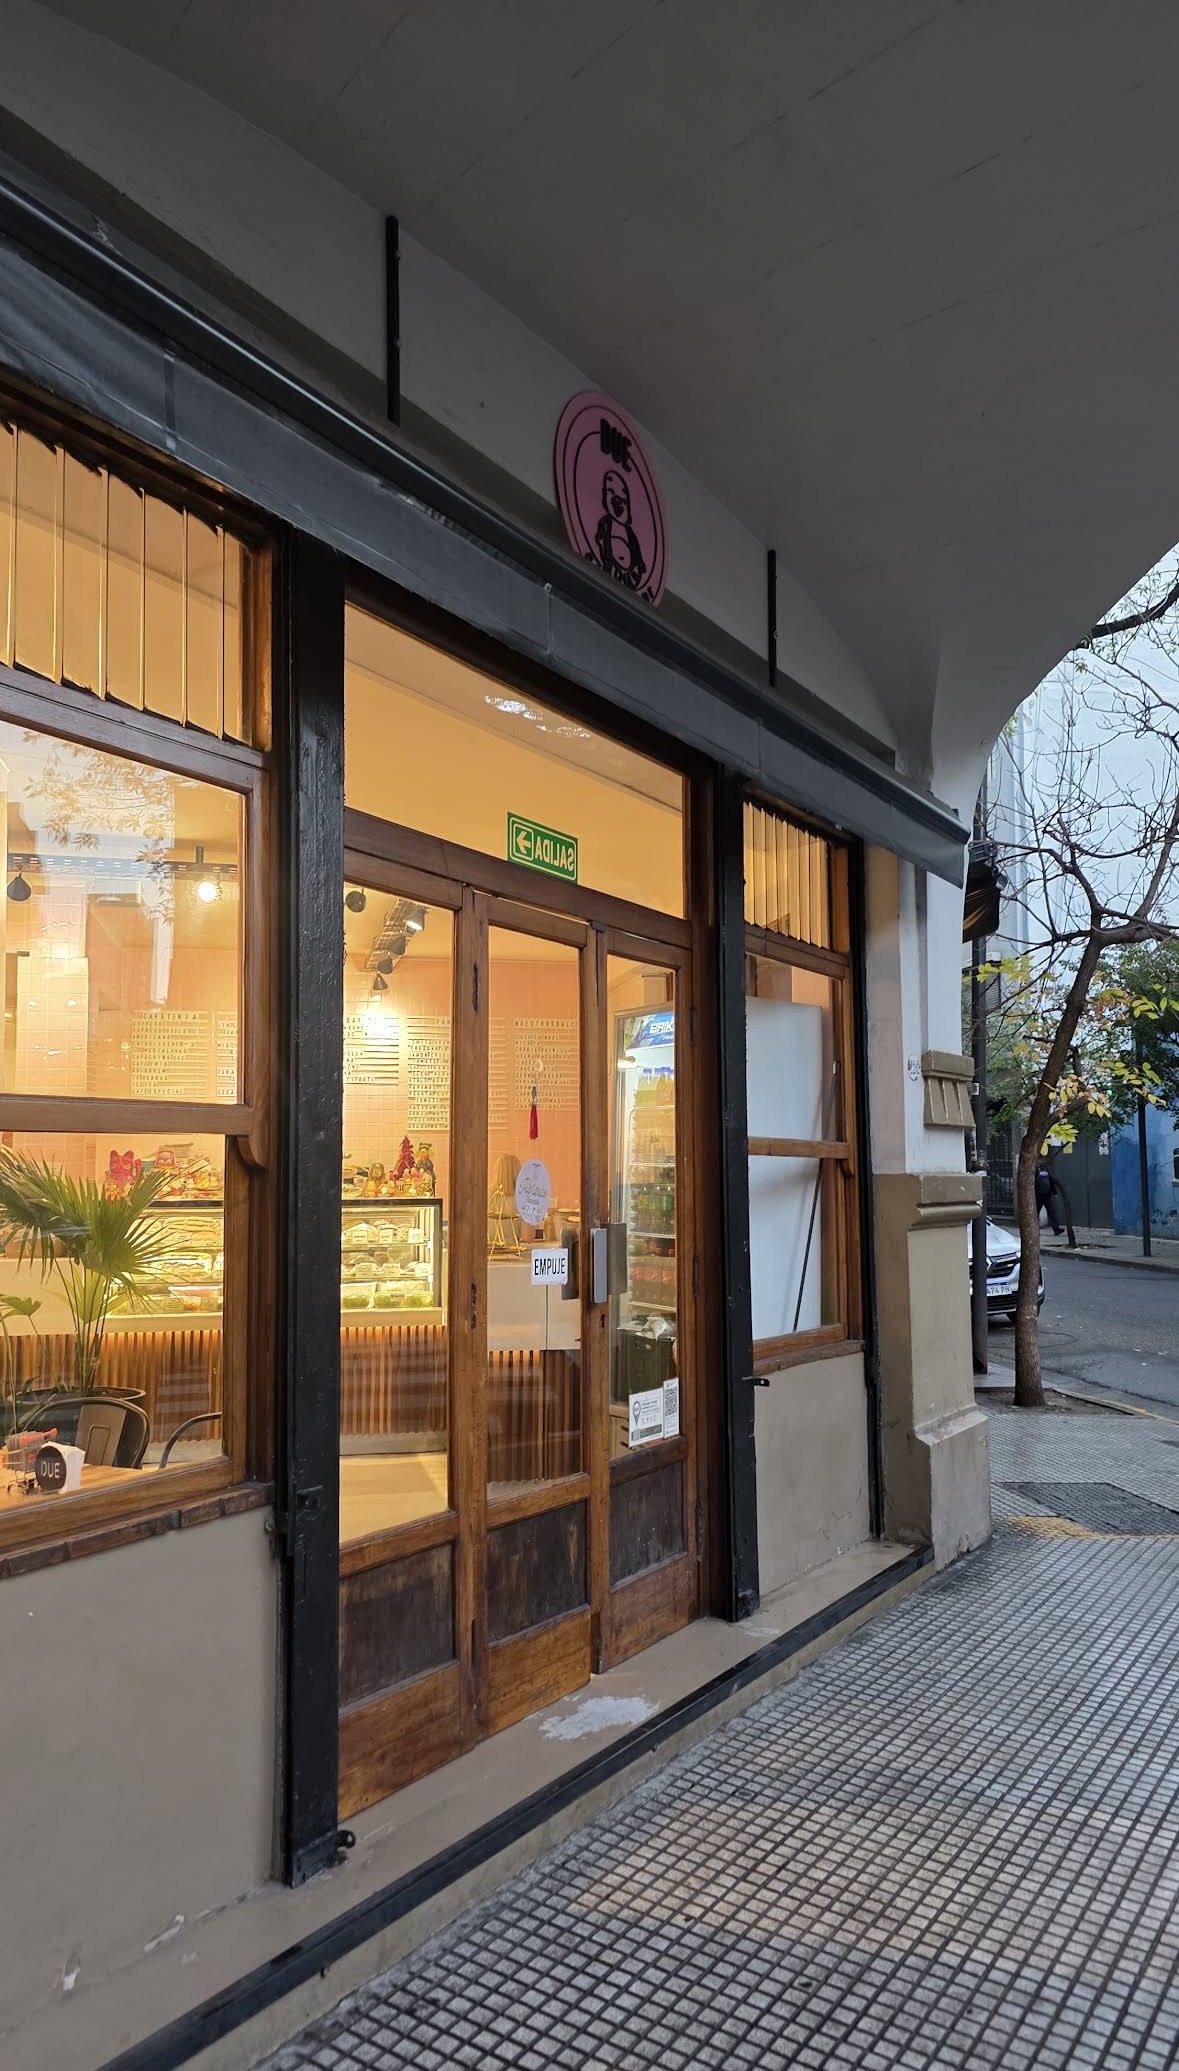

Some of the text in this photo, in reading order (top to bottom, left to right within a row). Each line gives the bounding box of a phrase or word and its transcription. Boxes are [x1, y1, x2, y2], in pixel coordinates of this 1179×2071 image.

[601, 418, 632, 473] DUE
[534, 1258, 565, 1276] EMPUJE
[41, 1460, 61, 1479] DUE
